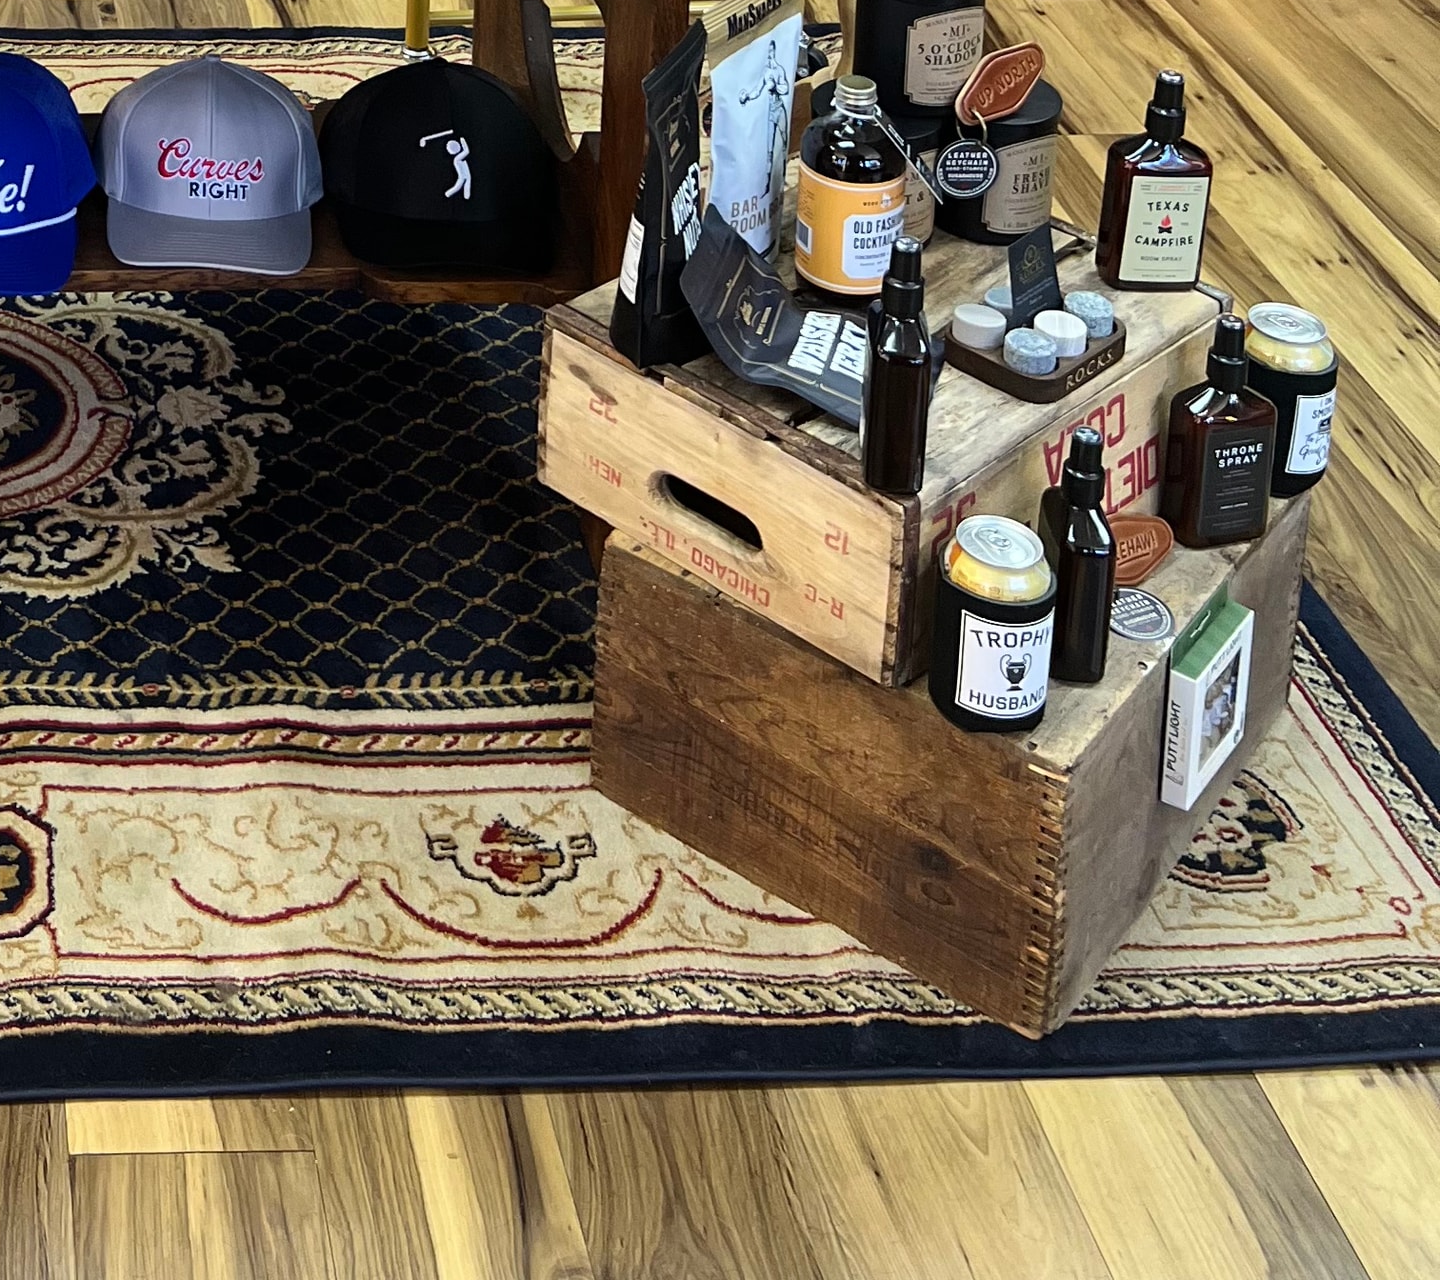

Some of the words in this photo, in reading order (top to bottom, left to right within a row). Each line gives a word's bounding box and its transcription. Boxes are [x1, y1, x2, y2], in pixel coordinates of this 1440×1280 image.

[917, 43, 925, 55] 5
[931, 33, 981, 55] O'CLOCK
[924, 46, 977, 66] SHADOW
[977, 86, 994, 108] UP
[995, 54, 1039, 95] NORTH
[156, 137, 265, 183] Curves
[947, 151, 988, 159] LEATHER
[1014, 166, 1050, 184] FRESH
[188, 181, 249, 202] RIGHT
[1011, 177, 1049, 195] SHAVE
[731, 196, 759, 218] BAR
[1147, 201, 1190, 212] TEXAS
[731, 213, 767, 234] ROOM
[853, 220, 873, 235] OLD
[1135, 235, 1194, 247] CAMPFIRE
[1214, 443, 1263, 459] THRONE
[1218, 454, 1258, 468] SPRAY
[969, 626, 1051, 648] TROPHY
[969, 685, 1044, 710] HUSBAND
[1169, 699, 1181, 737] LIGHT
[1167, 737, 1178, 771] PUTT
